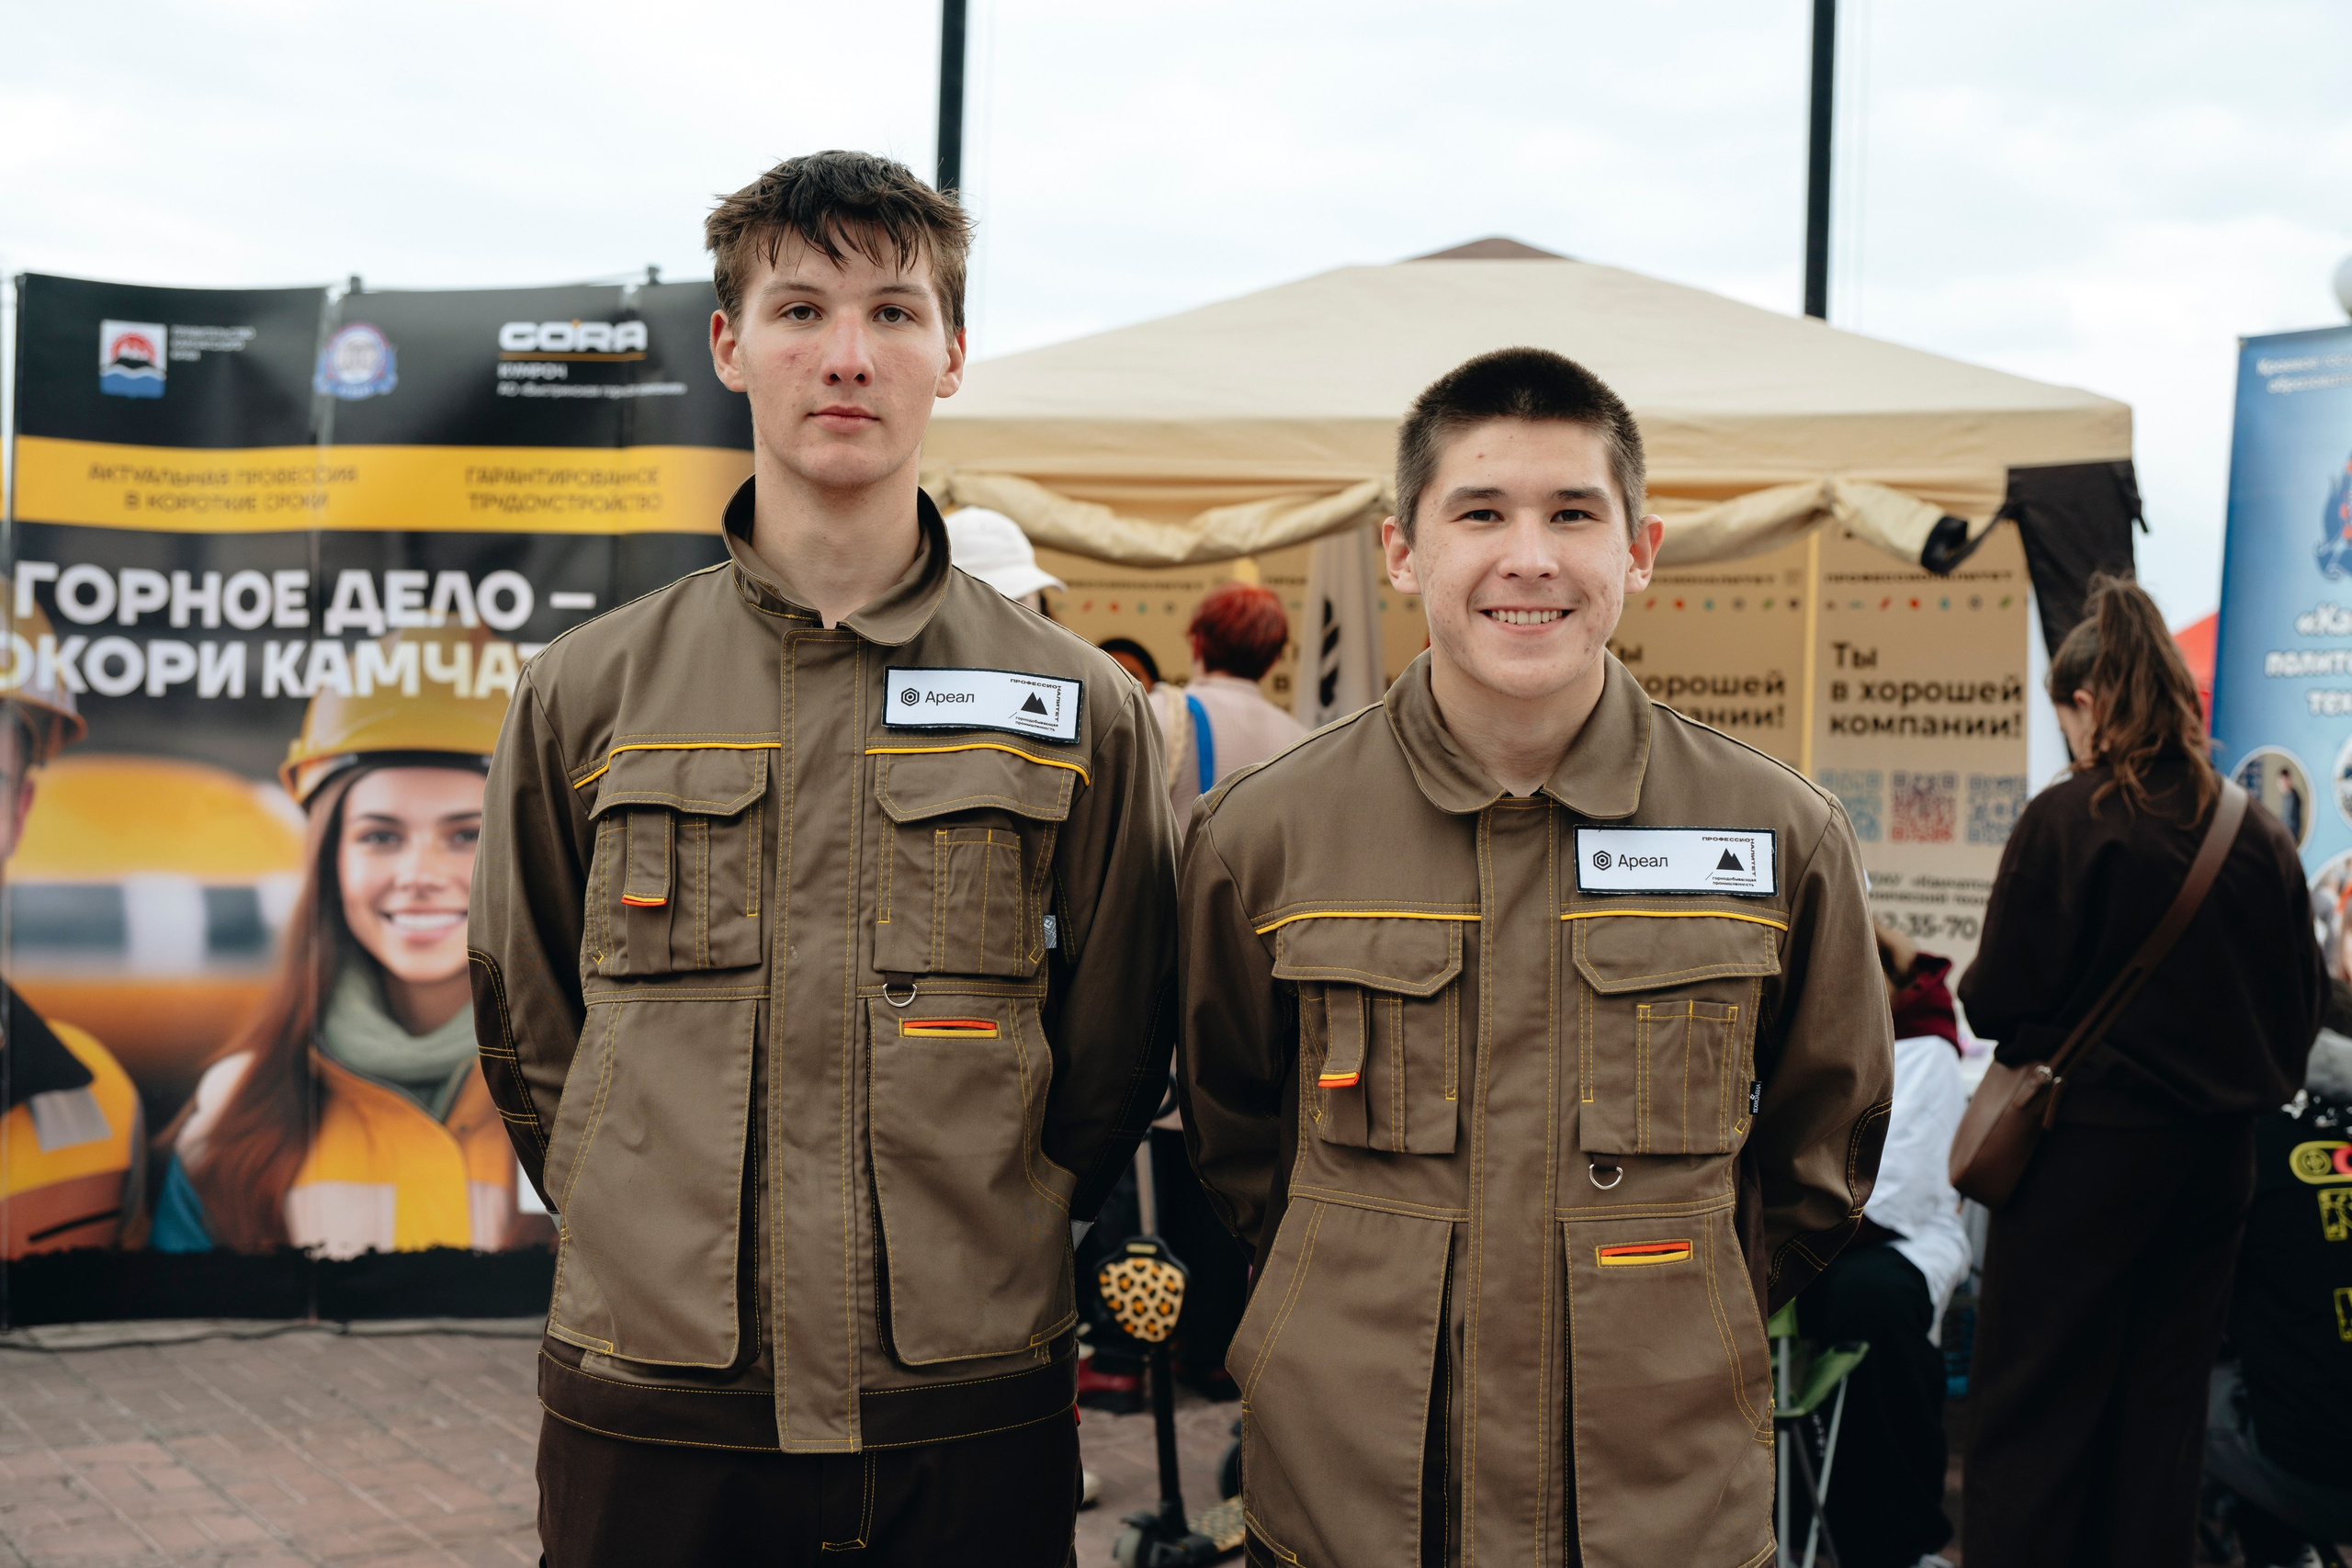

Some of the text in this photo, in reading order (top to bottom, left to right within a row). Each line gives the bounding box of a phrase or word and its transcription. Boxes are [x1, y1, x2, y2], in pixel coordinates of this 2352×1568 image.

[88, 463, 357, 488] АКТУАЛЬНАЯ ПРОФЕССИЯ
[466, 467, 661, 488] ГАРАНТИРОВАННОЕ
[126, 491, 329, 513] В КОРОТКИЕ СРОКИ
[468, 491, 662, 513] ТРУДОУСТРОЙСТВО
[15, 560, 311, 630] ГОРНОЕ
[323, 569, 535, 637] ДЕЛО
[1832, 641, 1877, 669] Ты
[925, 691, 975, 705] Ареал
[1638, 670, 1784, 700] орошей
[1831, 675, 2021, 709] в хорошей
[1683, 704, 1784, 730] ании!
[1830, 710, 2021, 738] компании!
[1618, 854, 1668, 870] Ареал
[1877, 912, 1978, 940] 2-35-70
